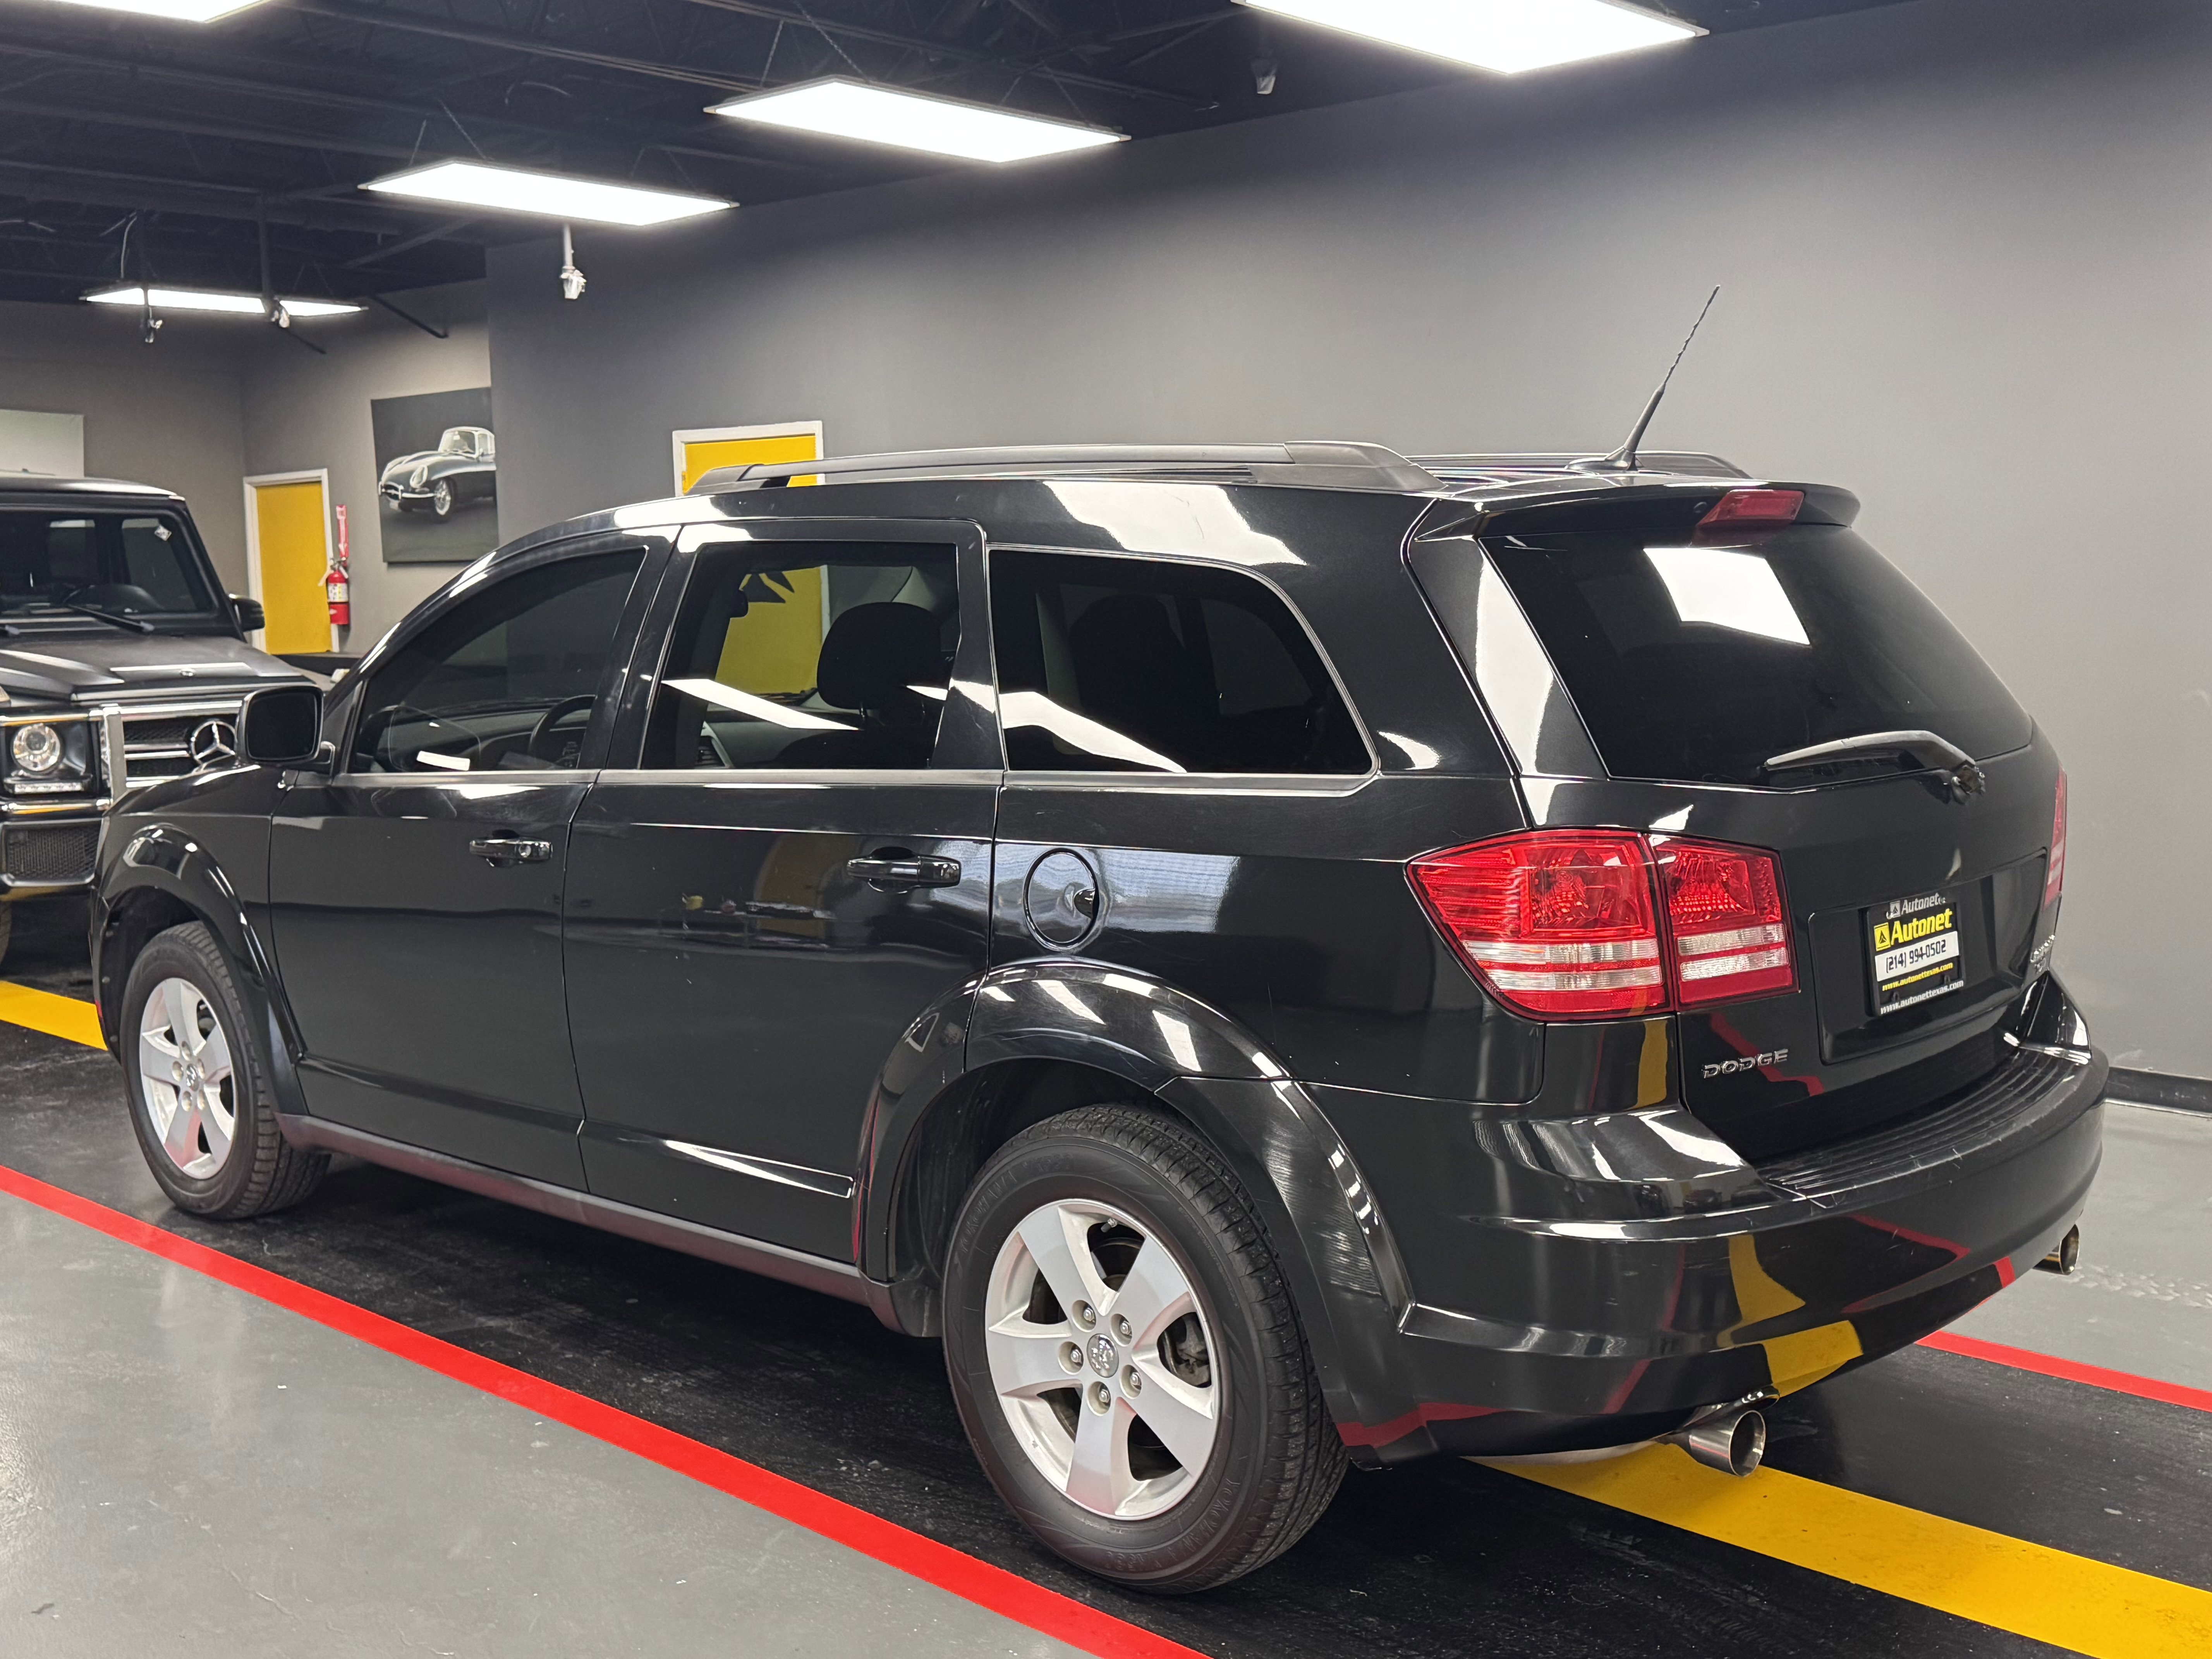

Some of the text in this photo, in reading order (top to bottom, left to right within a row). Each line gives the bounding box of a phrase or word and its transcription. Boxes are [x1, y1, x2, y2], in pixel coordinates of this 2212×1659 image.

[1901, 892, 1939, 915] Autonet
[1891, 908, 1953, 945] Autonet
[1886, 939, 1946, 973] (214) 994-0502
[1882, 962, 1953, 991] www.autonettexas.com
[1880, 979, 1964, 1015] www.autonettexas.com
[1703, 1048, 1788, 1079] DODGE
